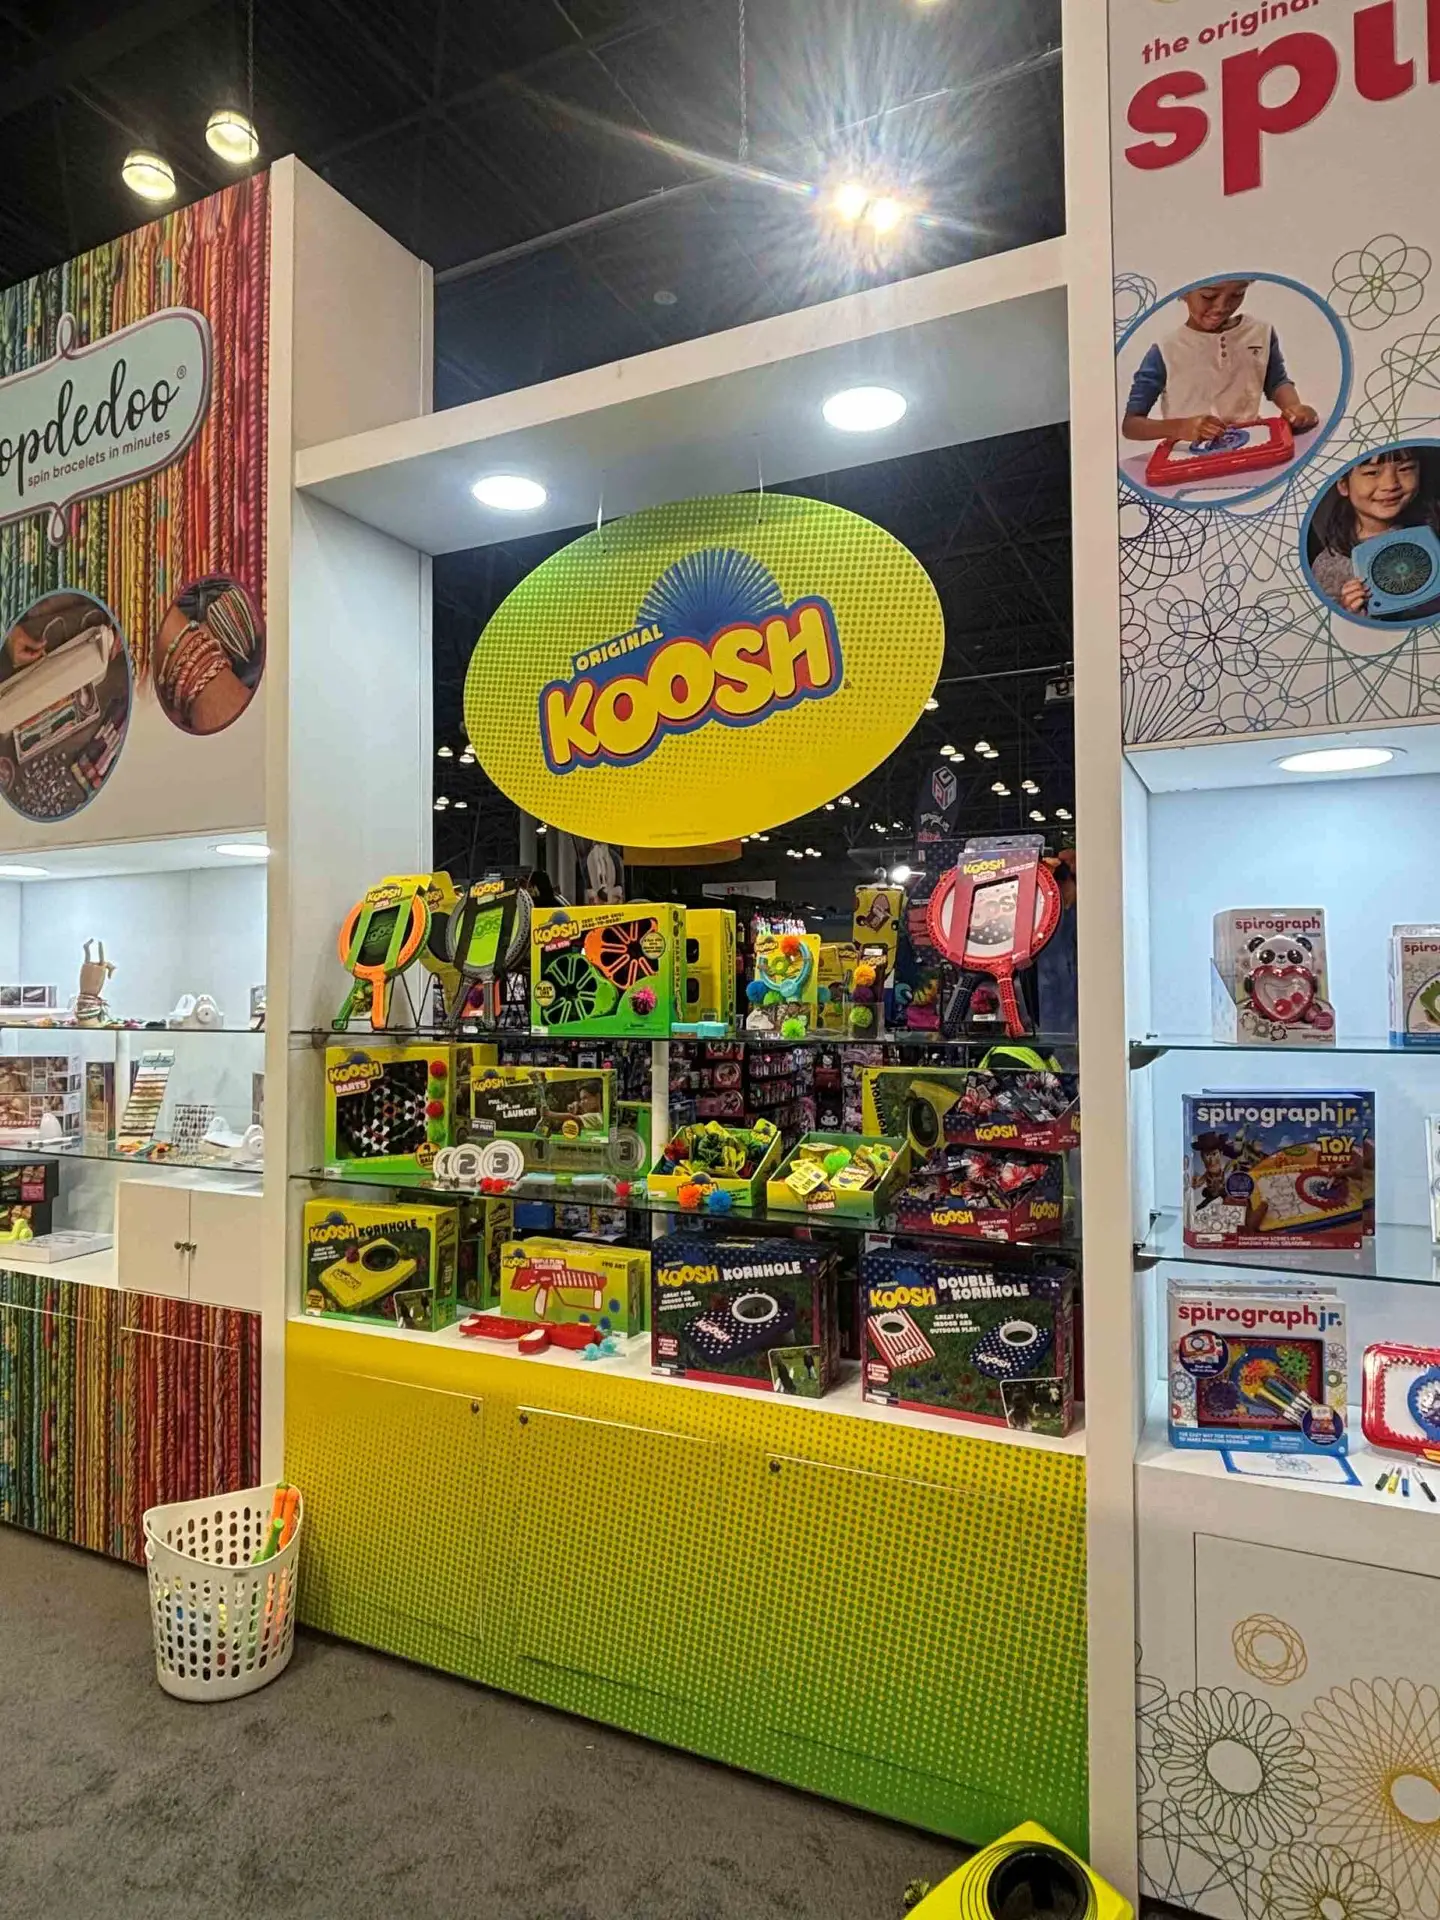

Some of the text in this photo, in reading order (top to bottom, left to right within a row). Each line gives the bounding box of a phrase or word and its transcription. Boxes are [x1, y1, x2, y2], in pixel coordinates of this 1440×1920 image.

[1142, 0, 1320, 65] the origina
[28, 429, 171, 488] spin bracelets in minutes
[576, 624, 665, 672] ORIGINAL
[547, 607, 833, 766] KOOSH
[963, 859, 1005, 875] KOOSH
[366, 888, 402, 903] KOOSH
[471, 881, 505, 897] KOOSH
[533, 921, 577, 944] KOOSH
[1235, 916, 1321, 933] spirograph
[329, 1063, 379, 1083] KOOSH
[335, 1081, 367, 1093] DARTS
[472, 1078, 504, 1092] KOOSH
[975, 1125, 1018, 1141] KOOSH
[1317, 1136, 1357, 1154] TOY
[460, 1154, 476, 1174] 2
[492, 1153, 509, 1173] 3
[931, 1210, 974, 1226] KOOSH
[1030, 1202, 1060, 1220] KOOSH
[309, 1219, 418, 1242] KOOSH KORNHOLE
[503, 1257, 529, 1268] KOOSH
[657, 1261, 803, 1287] KOOSH KORNHOLE
[937, 1274, 995, 1290] DOUBLE
[870, 1286, 937, 1309] KOOSH
[951, 1283, 1030, 1300] KORNHOLE
